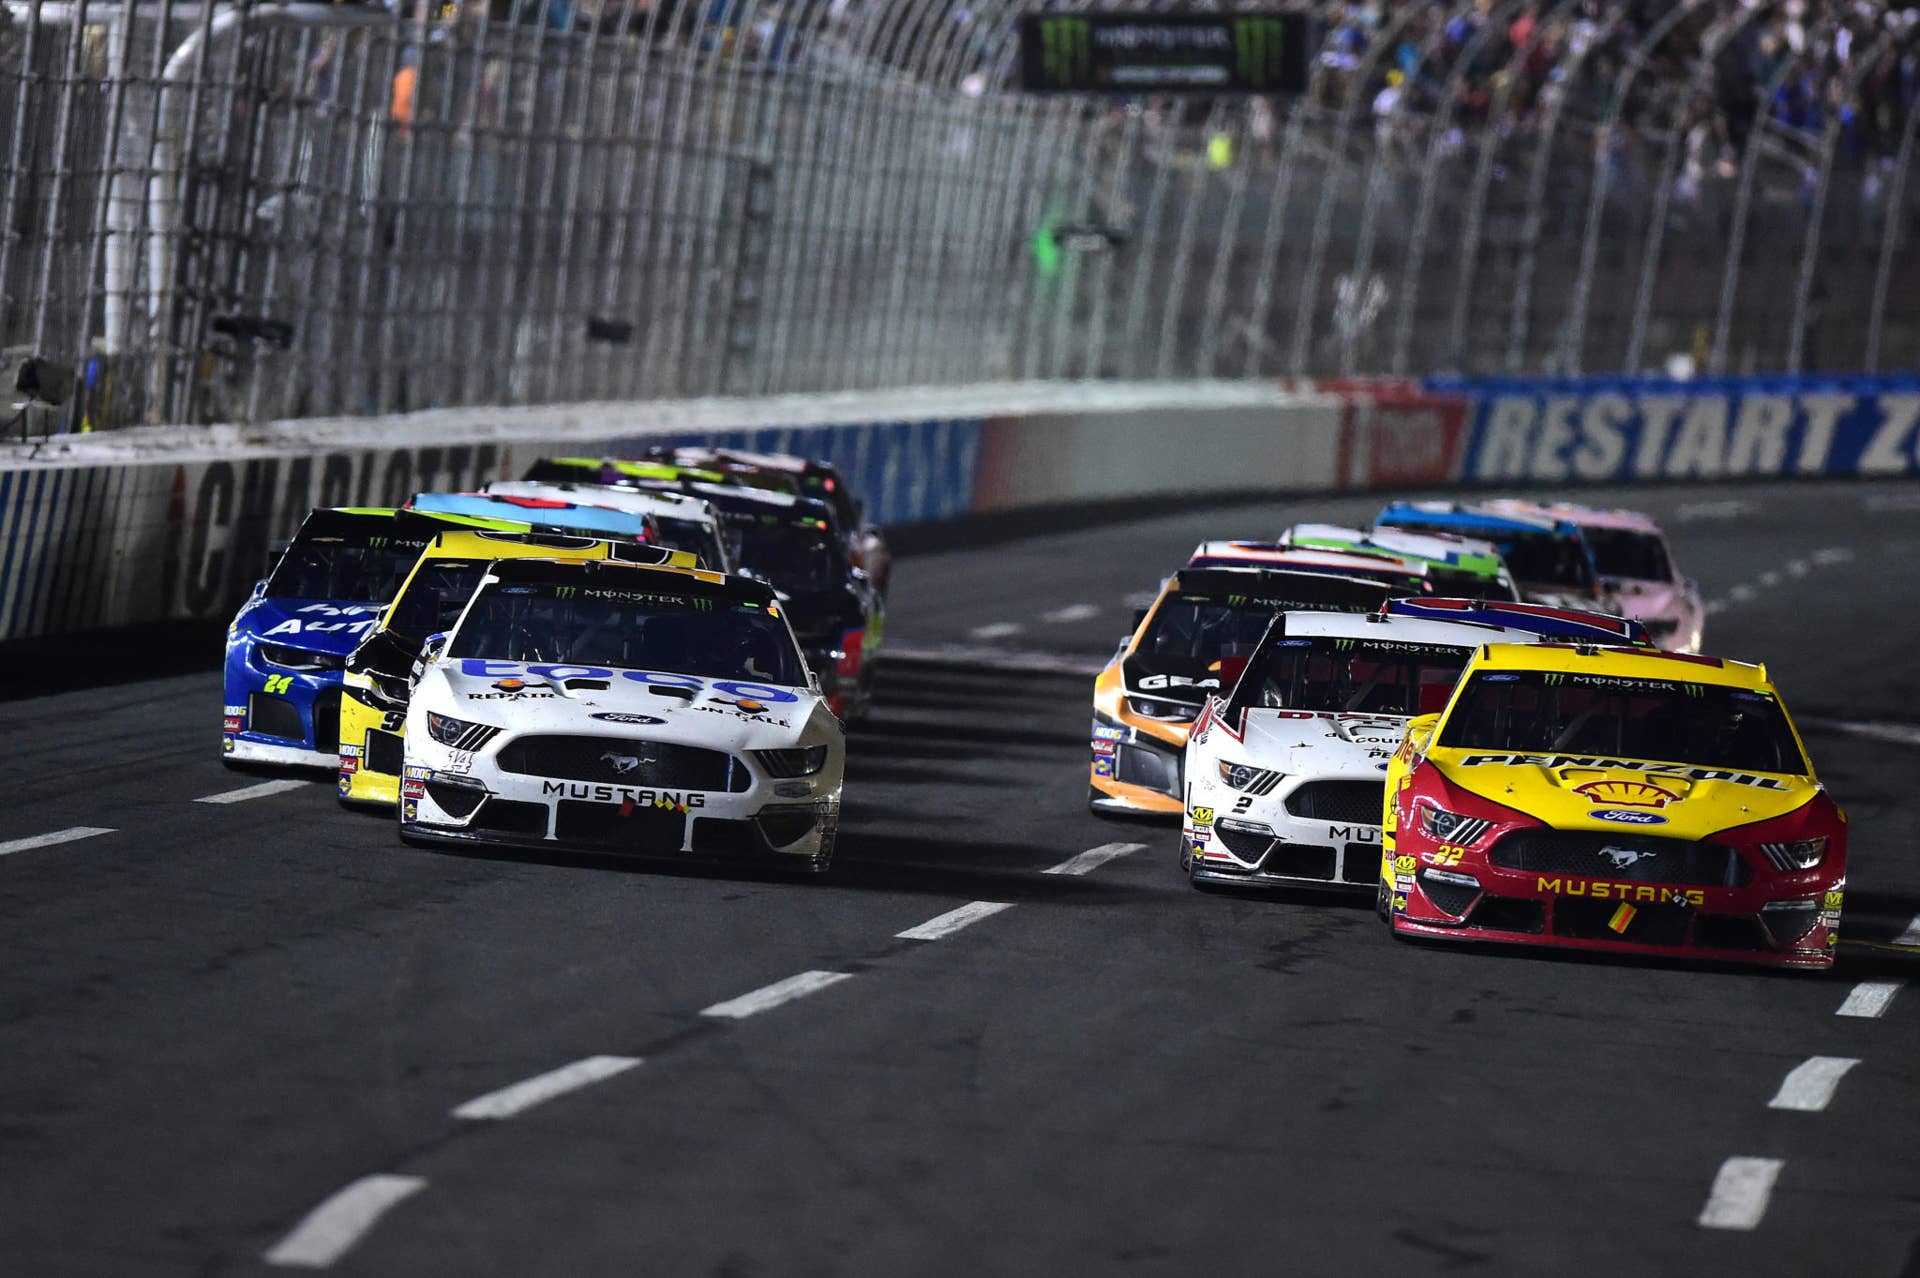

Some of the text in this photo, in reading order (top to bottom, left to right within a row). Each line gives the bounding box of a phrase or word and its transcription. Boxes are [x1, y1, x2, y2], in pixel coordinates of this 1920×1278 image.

[1479, 395, 1856, 477] RESTART
[1857, 393, 1920, 474] Z
[584, 588, 685, 605] MONSTER
[1253, 597, 1343, 612] MONSTER
[1362, 641, 1461, 655] MONSTER
[263, 674, 294, 695] 24
[1573, 675, 1677, 691] MONSTER
[467, 692, 556, 701] REPAIR
[441, 750, 476, 775] 14
[1460, 755, 1794, 793] PENNZOIL
[542, 780, 705, 808] MUSTANG
[1329, 825, 1383, 843] MU
[1434, 845, 1464, 867] 22
[1537, 877, 1705, 905] MUSTANG
